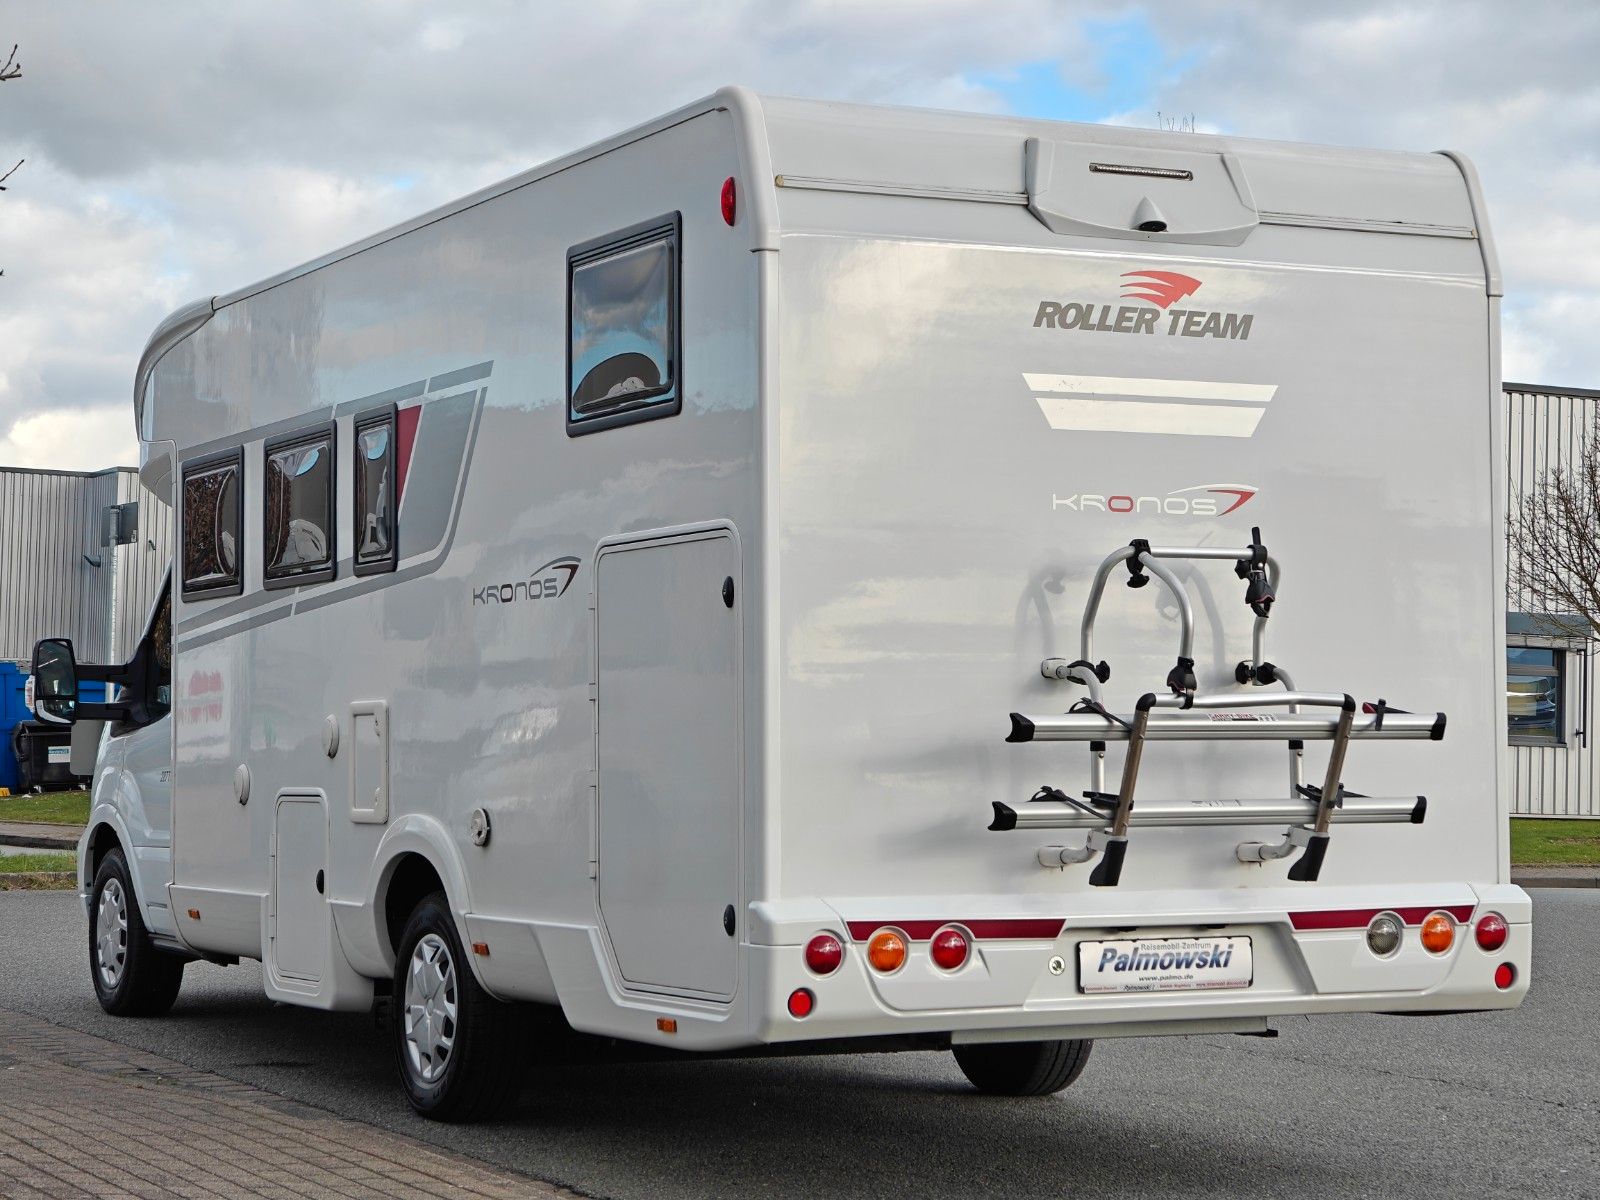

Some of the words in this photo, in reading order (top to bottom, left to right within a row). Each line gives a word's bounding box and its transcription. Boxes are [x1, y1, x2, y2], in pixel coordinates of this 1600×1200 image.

[1033, 301, 1160, 335] ROLLER
[1168, 309, 1253, 340] TEAM
[1098, 943, 1234, 973] Palmowski
[1138, 973, 1194, 982] www.palmo.de
